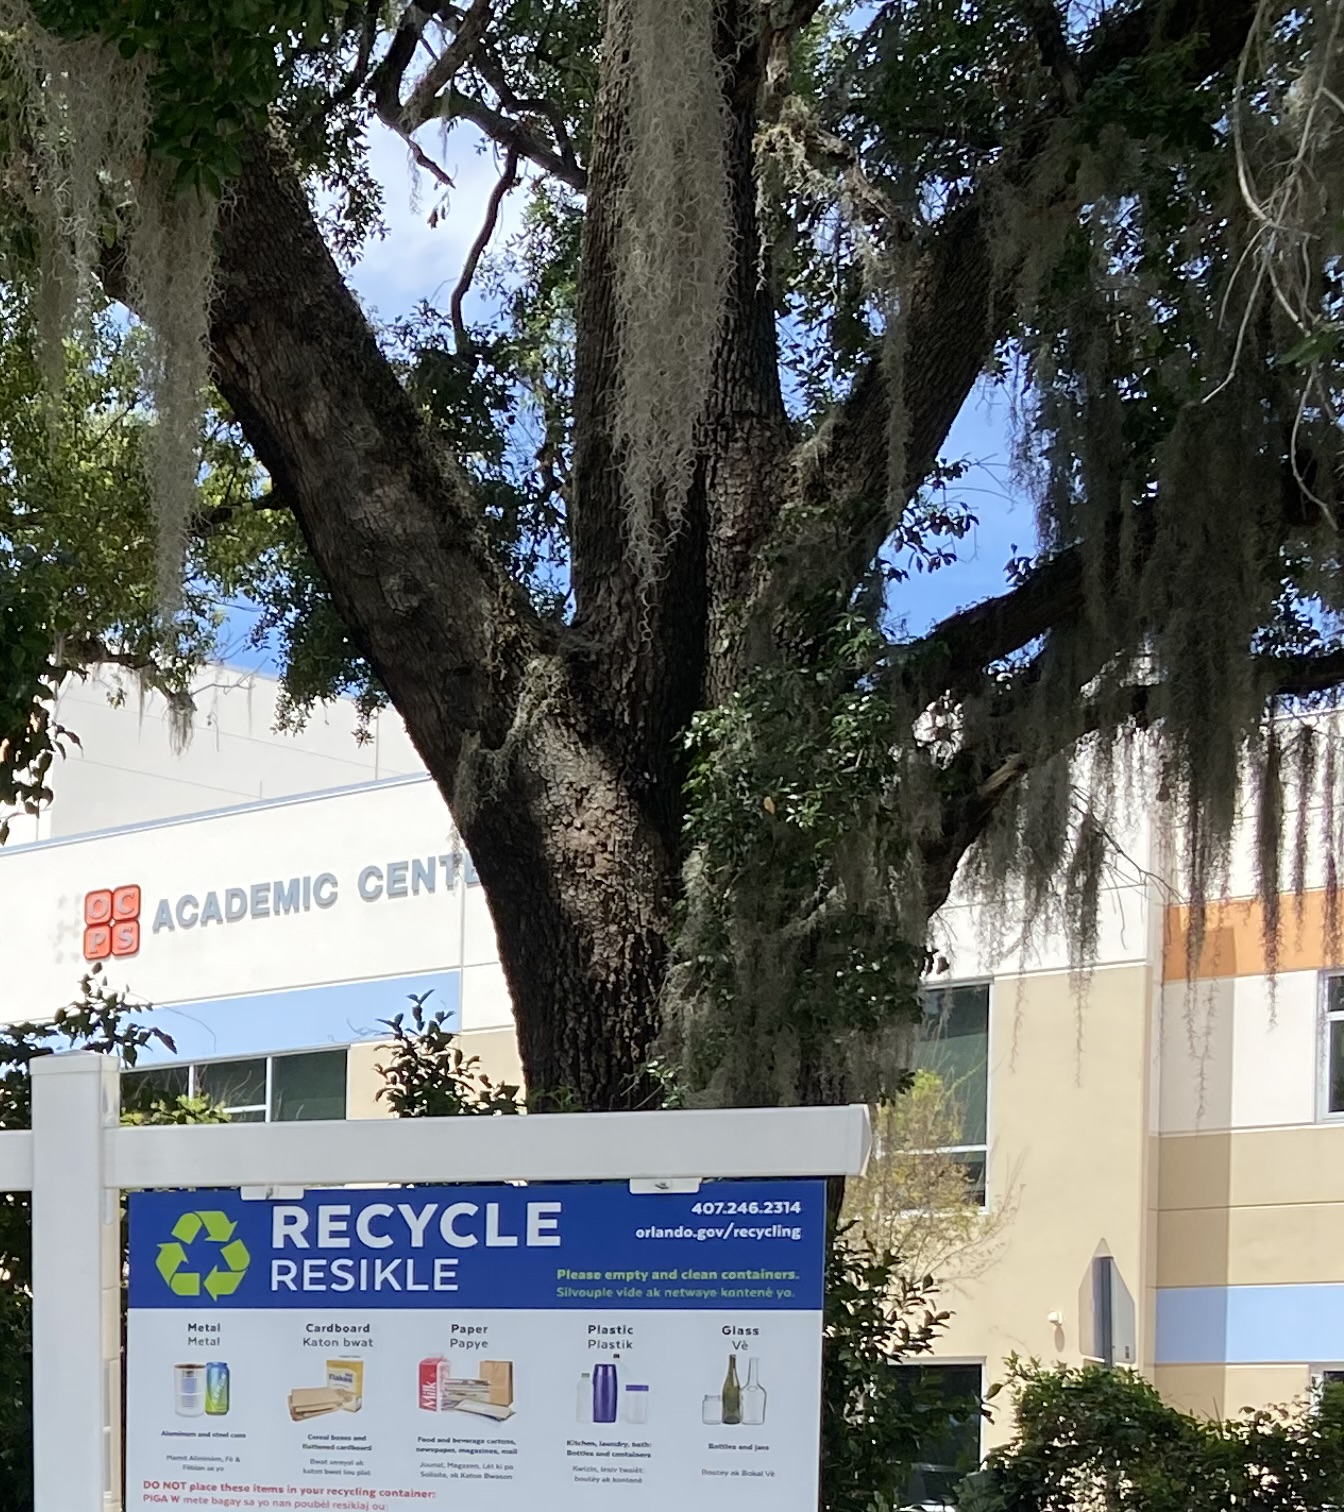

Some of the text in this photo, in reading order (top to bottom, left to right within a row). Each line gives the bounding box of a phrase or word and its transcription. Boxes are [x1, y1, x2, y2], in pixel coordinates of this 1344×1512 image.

[152, 873, 338, 933] ACADEMIC
[691, 1201, 801, 1215] 407.246.2314
[272, 1203, 562, 1249] RECYCLE
[635, 1223, 802, 1241] orlando.gov/recycling
[270, 1258, 459, 1292] RESIKLE
[556, 1268, 801, 1283] Please empty and clean containers.
[616, 1287, 643, 1298] vide
[646, 1287, 661, 1298] ak
[187, 1323, 221, 1332] Metal
[306, 1323, 370, 1333] Cardboard
[451, 1324, 488, 1337] Paper
[588, 1324, 634, 1335] Plastic
[721, 1325, 760, 1336] Glass
[187, 1336, 221, 1346] Metal
[303, 1337, 374, 1347] Katon bwat
[449, 1338, 489, 1350] Papye
[588, 1338, 633, 1350] Plastik
[422, 1380, 437, 1410] Milk
[738, 1443, 753, 1451] and
[143, 1480, 436, 1499] DO NOT place these items in your recycling container:
[143, 1494, 169, 1503] PIGA
[171, 1494, 180, 1503] W
[183, 1496, 209, 1505] mete
[212, 1495, 241, 1507] bagay
[243, 1498, 255, 1506] sa
[258, 1499, 270, 1508] yo
[272, 1499, 291, 1507] nan
